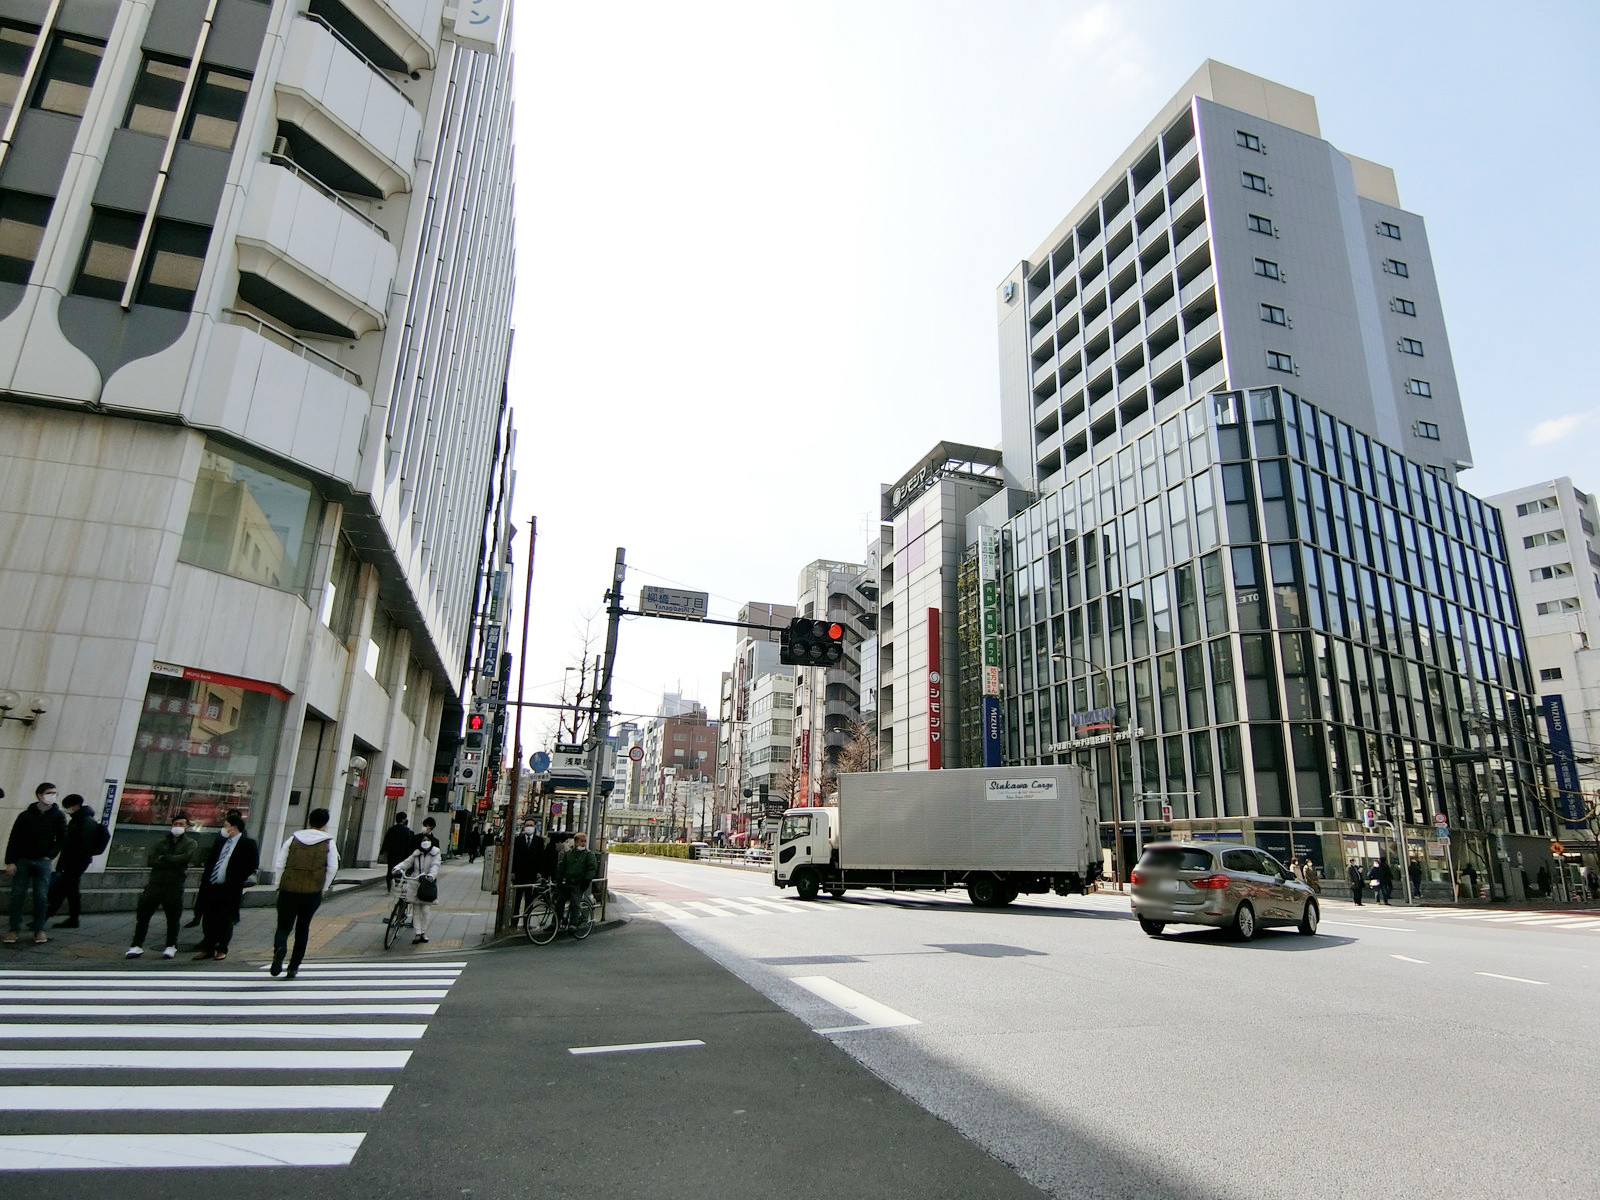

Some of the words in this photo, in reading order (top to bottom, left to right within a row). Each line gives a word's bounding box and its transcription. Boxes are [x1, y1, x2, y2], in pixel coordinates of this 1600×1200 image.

[901, 466, 926, 499] シモジマ
[648, 592, 704, 608] 柳橋二丁目
[655, 604, 690, 613] Yanagibashi
[484, 628, 499, 673] 岩田レーベル
[930, 688, 940, 742] シモジマ
[1550, 701, 1562, 731] MIZUHO
[1031, 780, 1053, 790] Cargo
